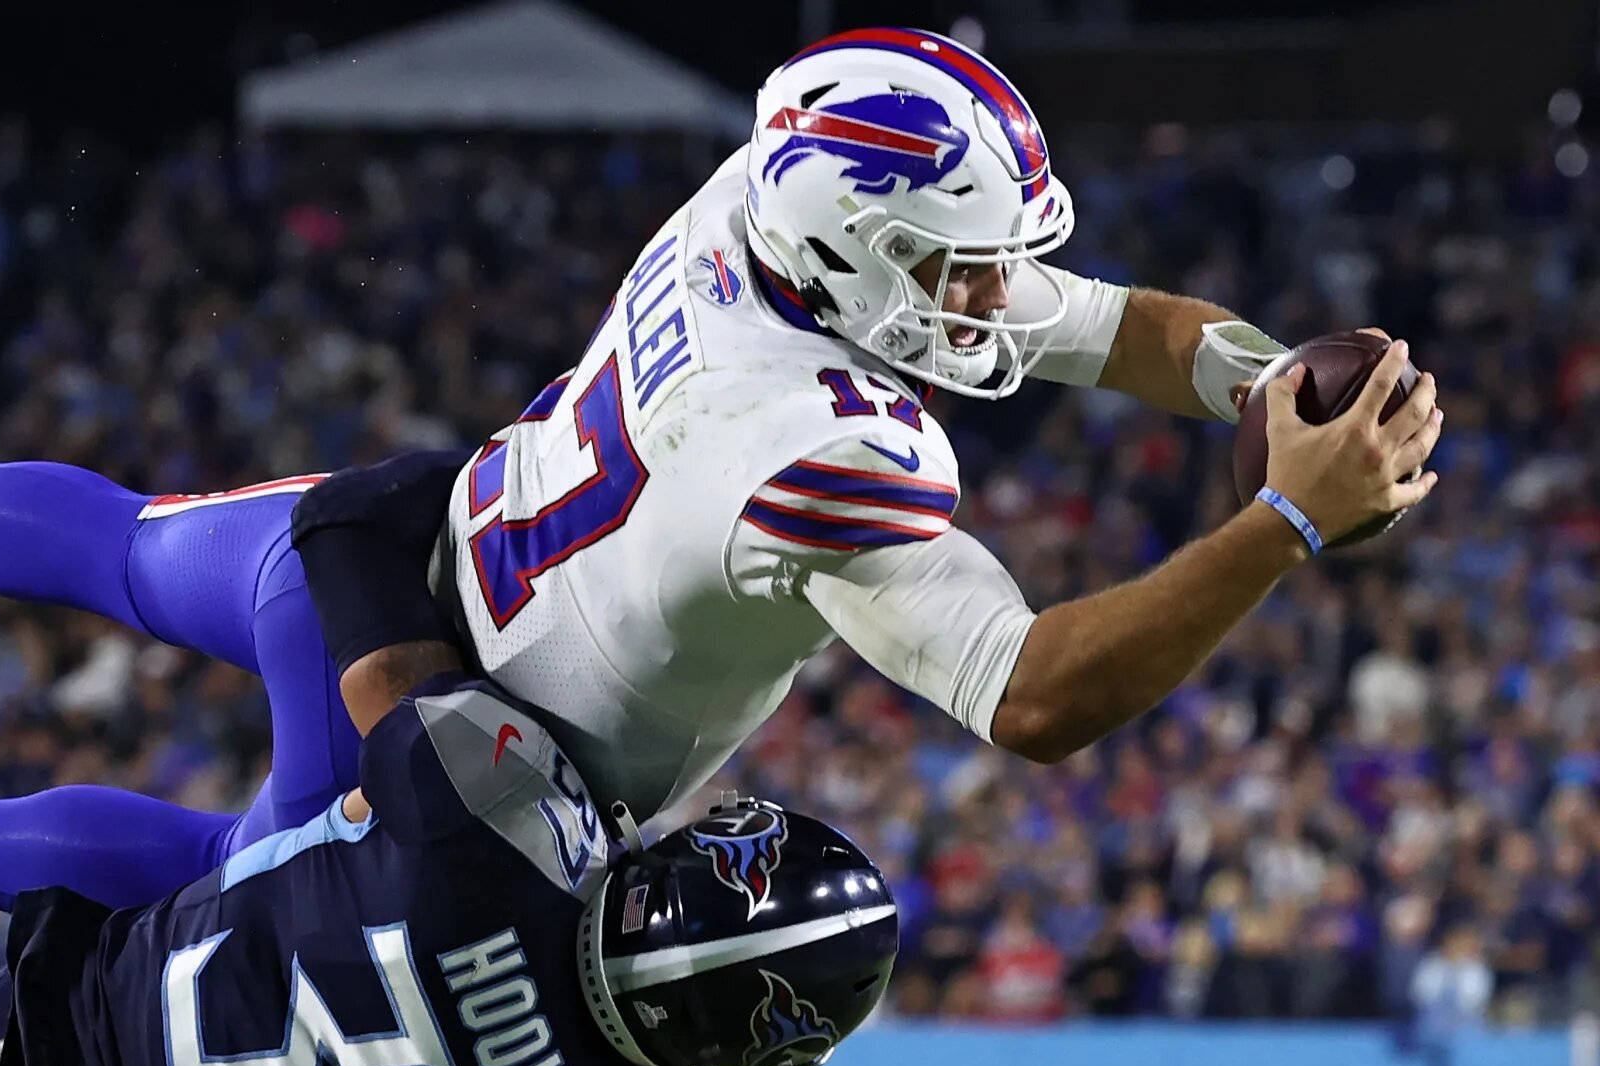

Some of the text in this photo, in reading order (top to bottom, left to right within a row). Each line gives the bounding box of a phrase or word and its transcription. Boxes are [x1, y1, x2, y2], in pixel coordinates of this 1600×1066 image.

[625, 235, 692, 411] ALLEN
[817, 368, 923, 431] 17
[469, 294, 650, 633] 17
